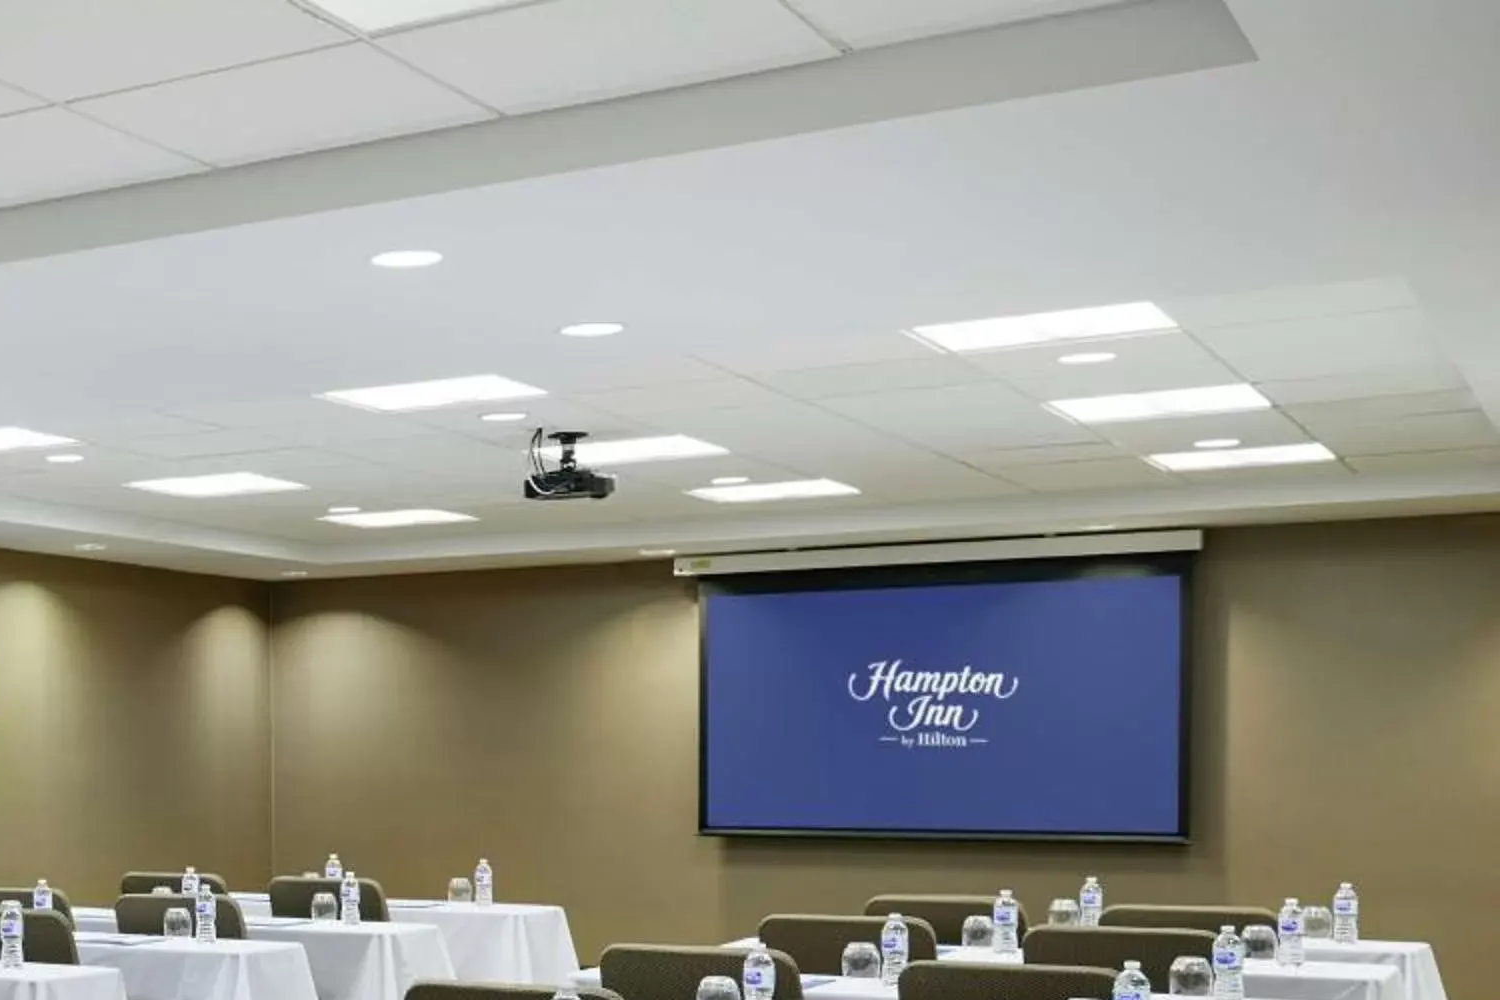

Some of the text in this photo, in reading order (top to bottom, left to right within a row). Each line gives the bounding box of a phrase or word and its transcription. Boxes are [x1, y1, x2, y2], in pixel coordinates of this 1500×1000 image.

[848, 659, 1019, 701] Hampton
[889, 695, 979, 731] Inn
[901, 731, 967, 749] by Hilton
